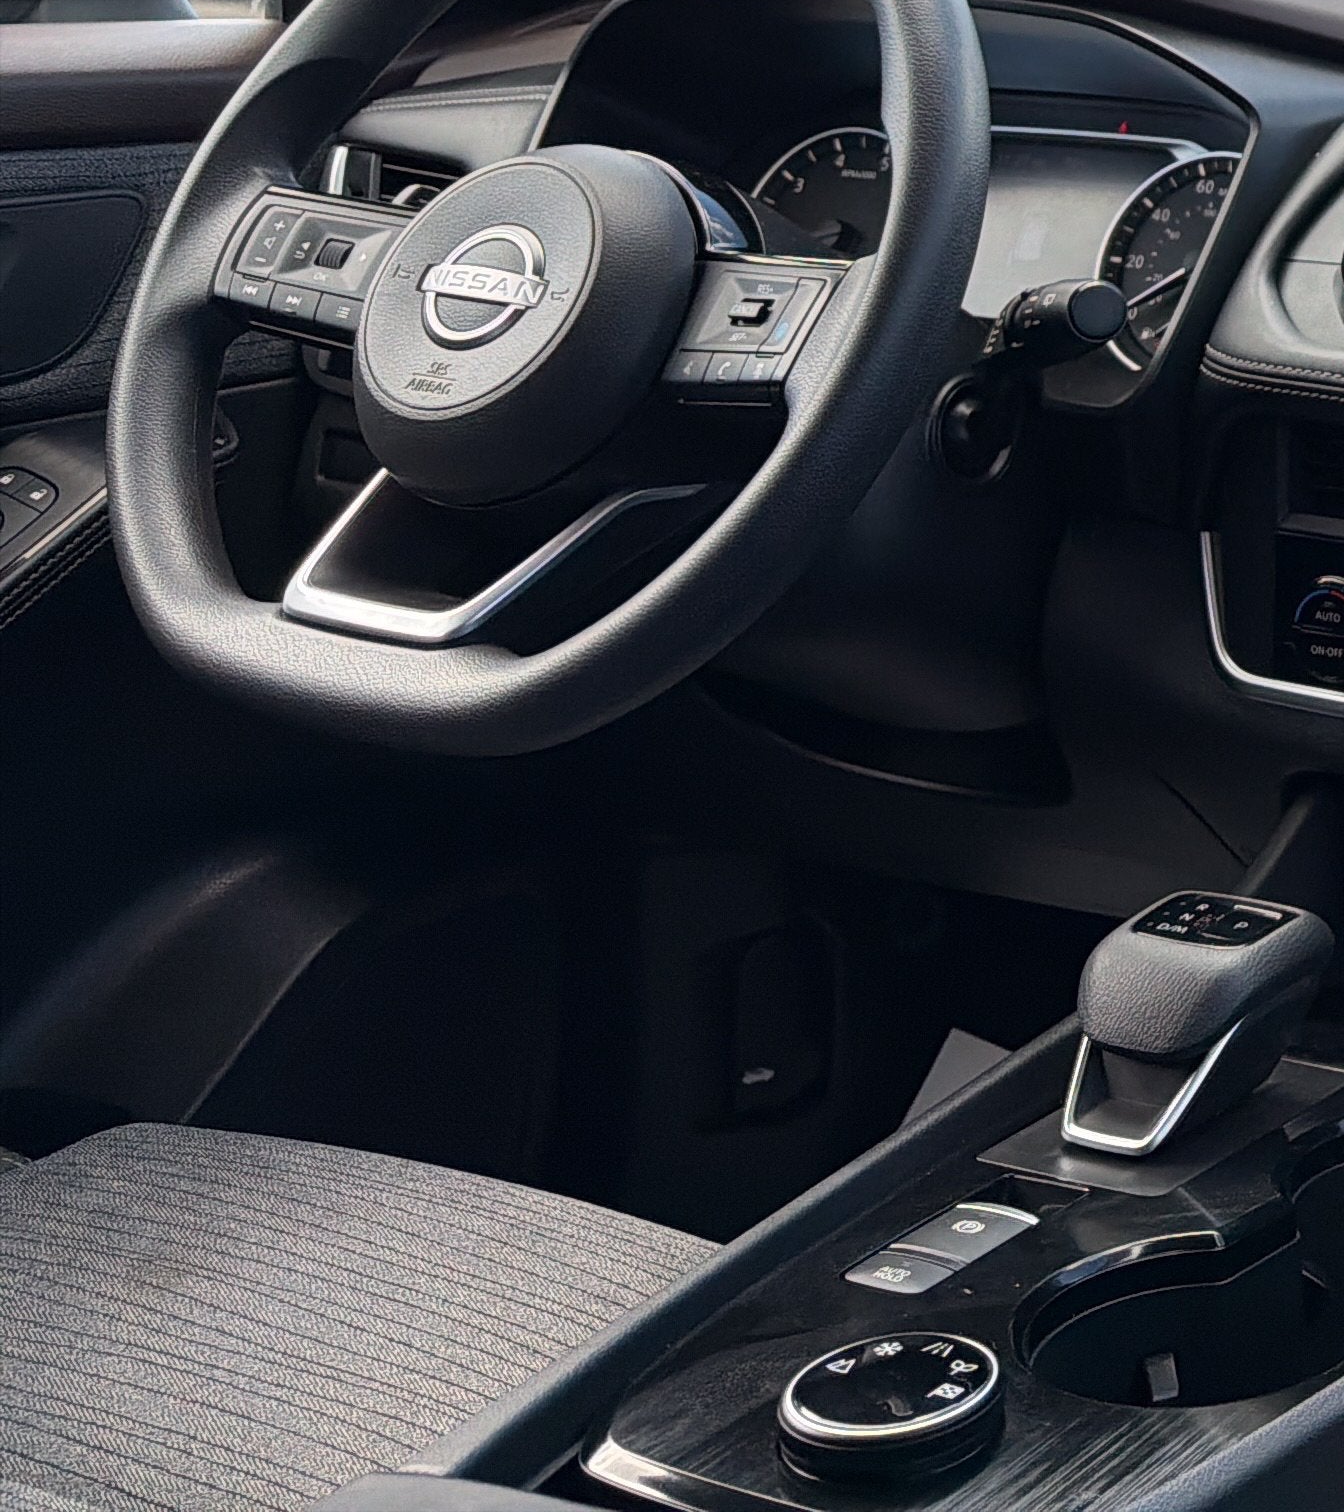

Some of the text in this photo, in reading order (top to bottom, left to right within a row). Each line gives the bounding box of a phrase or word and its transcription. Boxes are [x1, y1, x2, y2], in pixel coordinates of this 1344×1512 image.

[793, 177, 805, 193] 3
[1196, 179, 1215, 194] 60
[1151, 208, 1171, 222] 40
[1125, 254, 1145, 269] 20
[424, 266, 546, 306] NISSAN
[1127, 306, 1138, 321] 0
[405, 378, 454, 395] AIRBAG
[1315, 610, 1341, 624] AUTO
[1233, 920, 1249, 930] P
[872, 1271, 905, 1283] HOLD
[878, 1265, 912, 1278] AUTO
